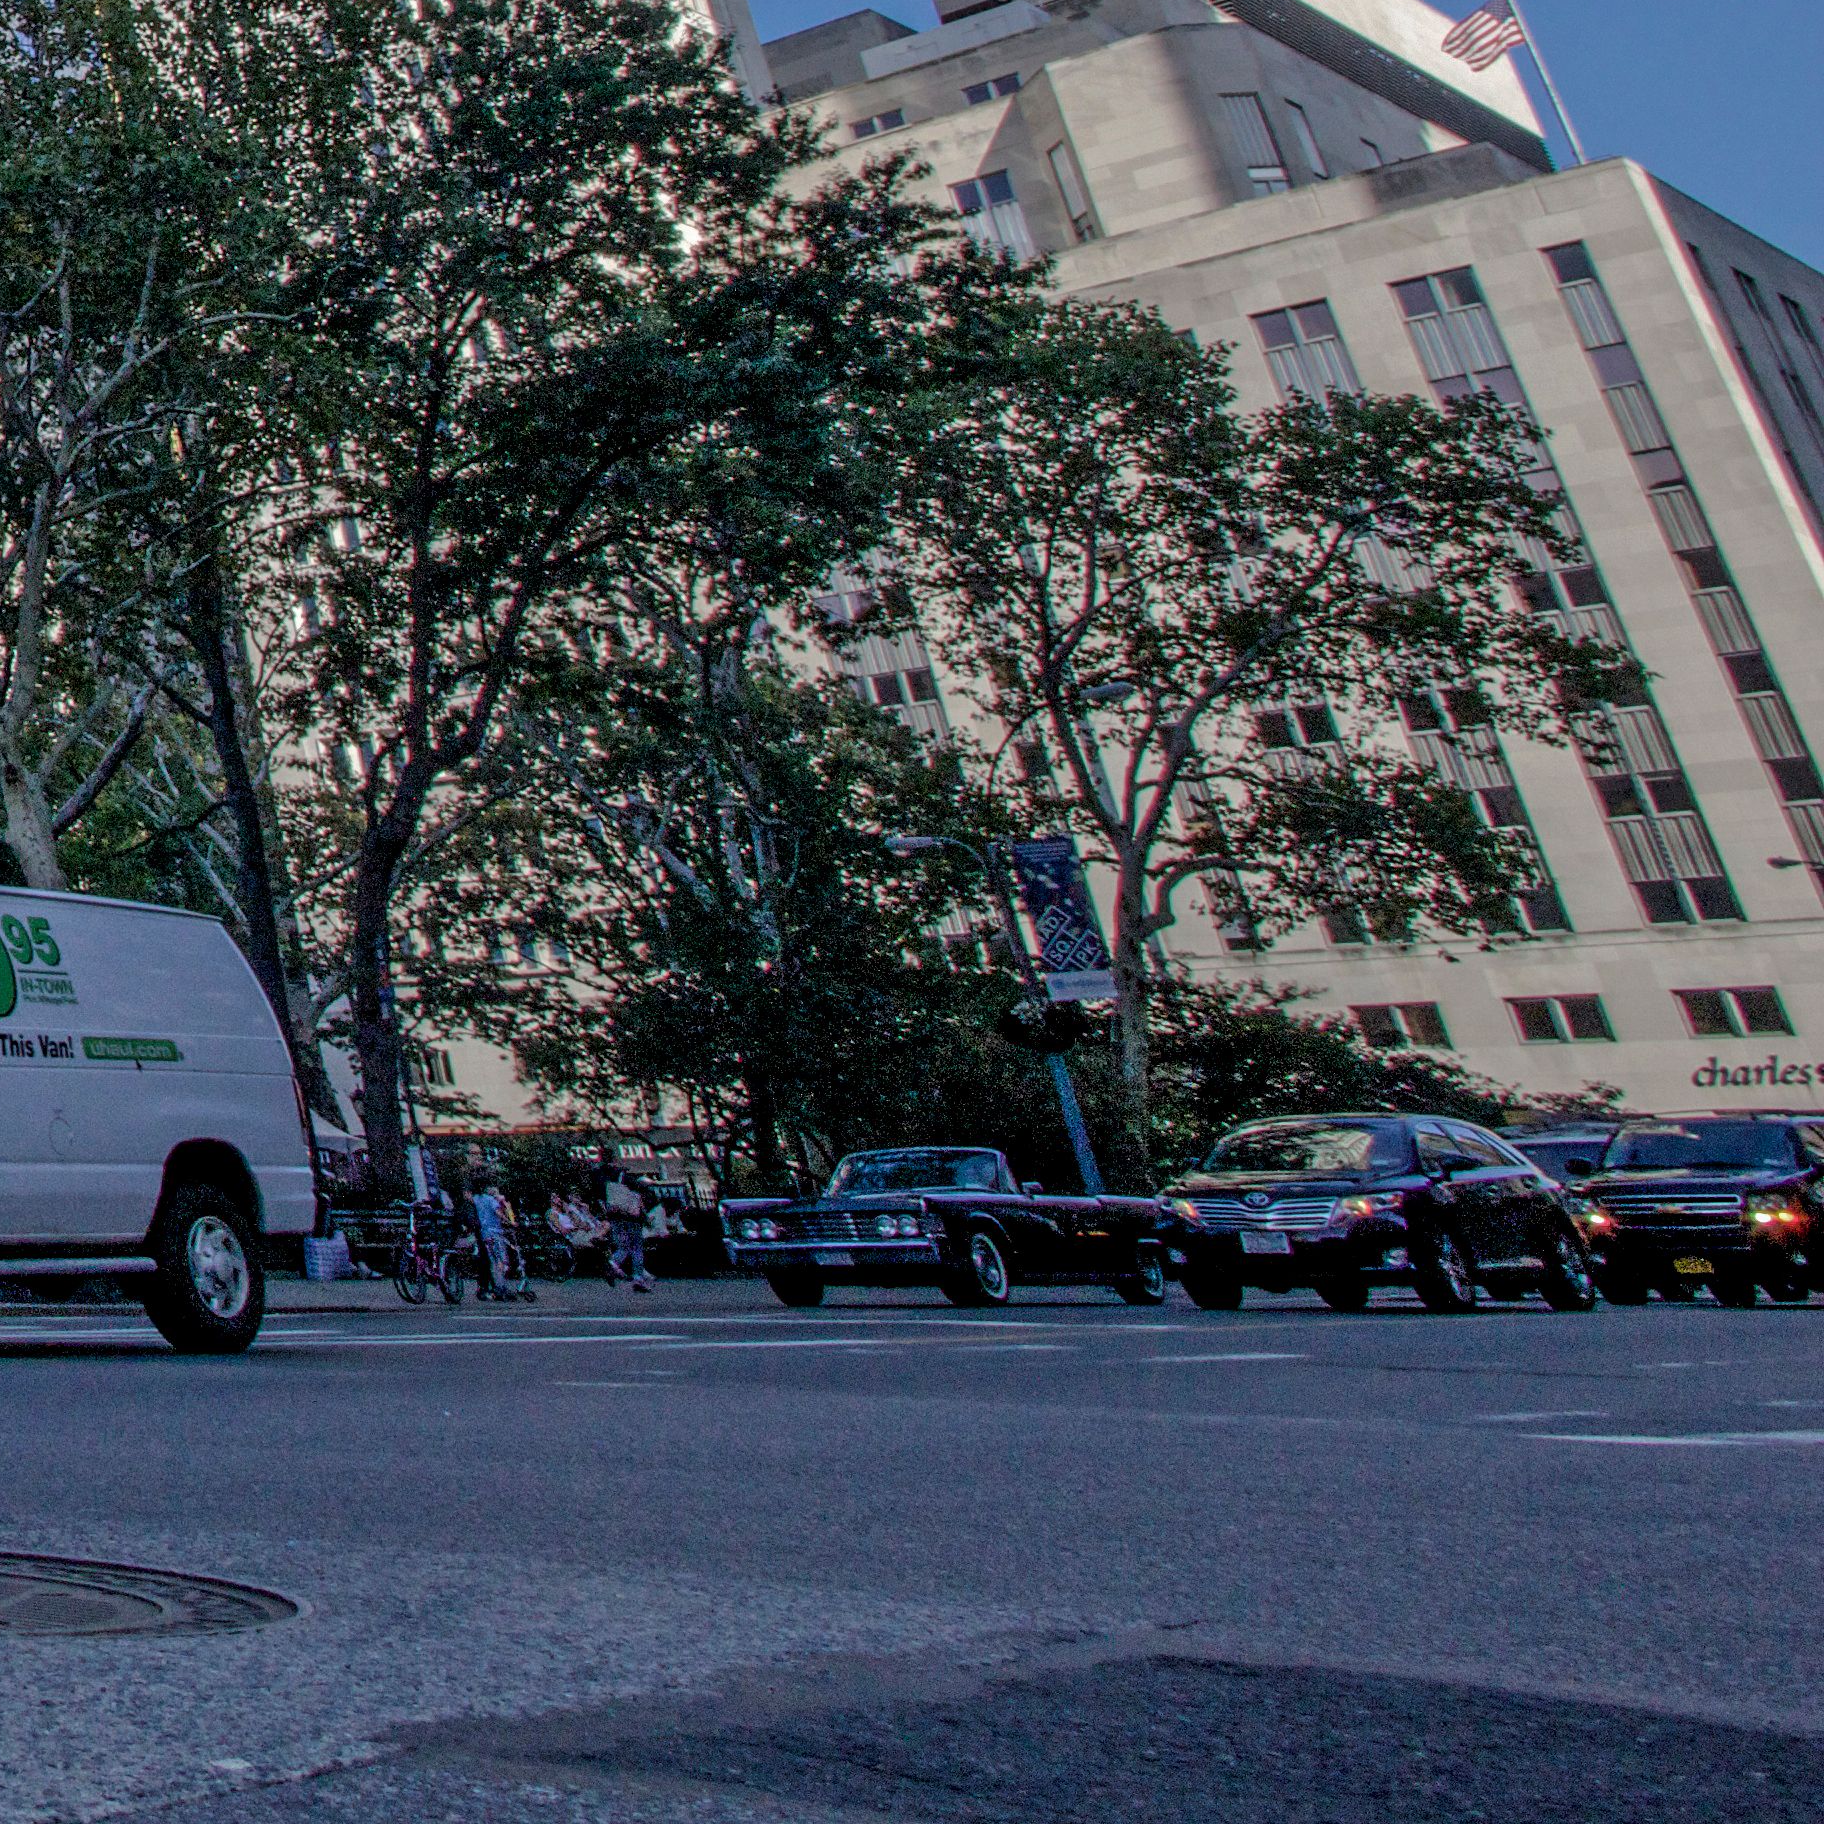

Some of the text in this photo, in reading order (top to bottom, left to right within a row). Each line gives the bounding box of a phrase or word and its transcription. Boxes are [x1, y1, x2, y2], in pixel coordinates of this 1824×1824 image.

[39, 1035, 74, 1059] Van!
[89, 1039, 173, 1058] uhaul.com
[1692, 1054, 1812, 1087] charles
